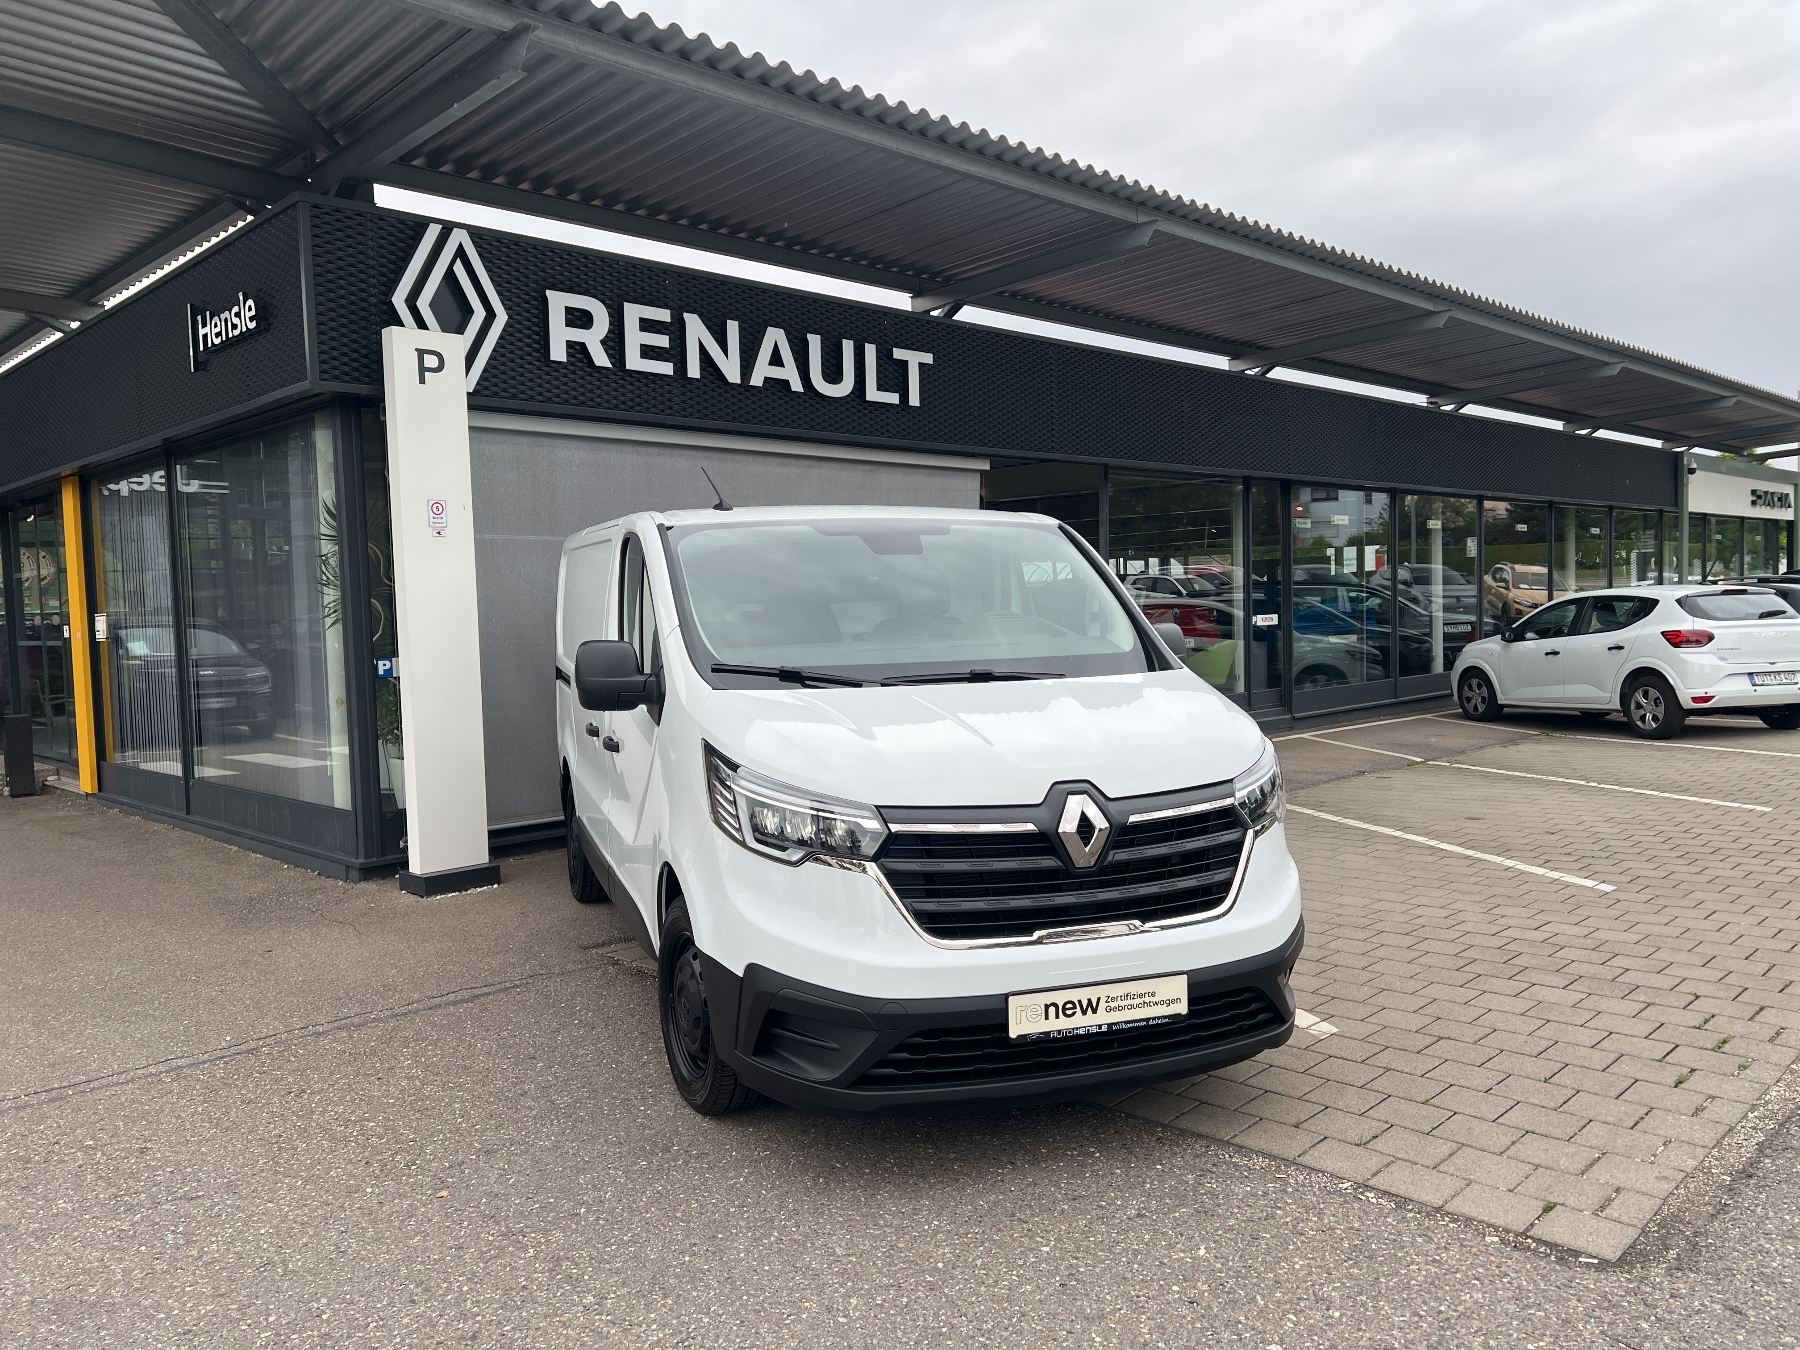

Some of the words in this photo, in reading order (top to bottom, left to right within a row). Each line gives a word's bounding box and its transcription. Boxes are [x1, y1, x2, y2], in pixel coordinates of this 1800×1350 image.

[197, 292, 257, 352] Hensle
[545, 289, 934, 407] RENAULT
[414, 347, 446, 385] P
[1750, 489, 1793, 509] DACIA
[377, 660, 392, 675] P
[1105, 990, 1156, 1004] Zertifizierte
[1105, 997, 1182, 1013] Gebrauchtwagen
[1015, 996, 1102, 1026] renew
